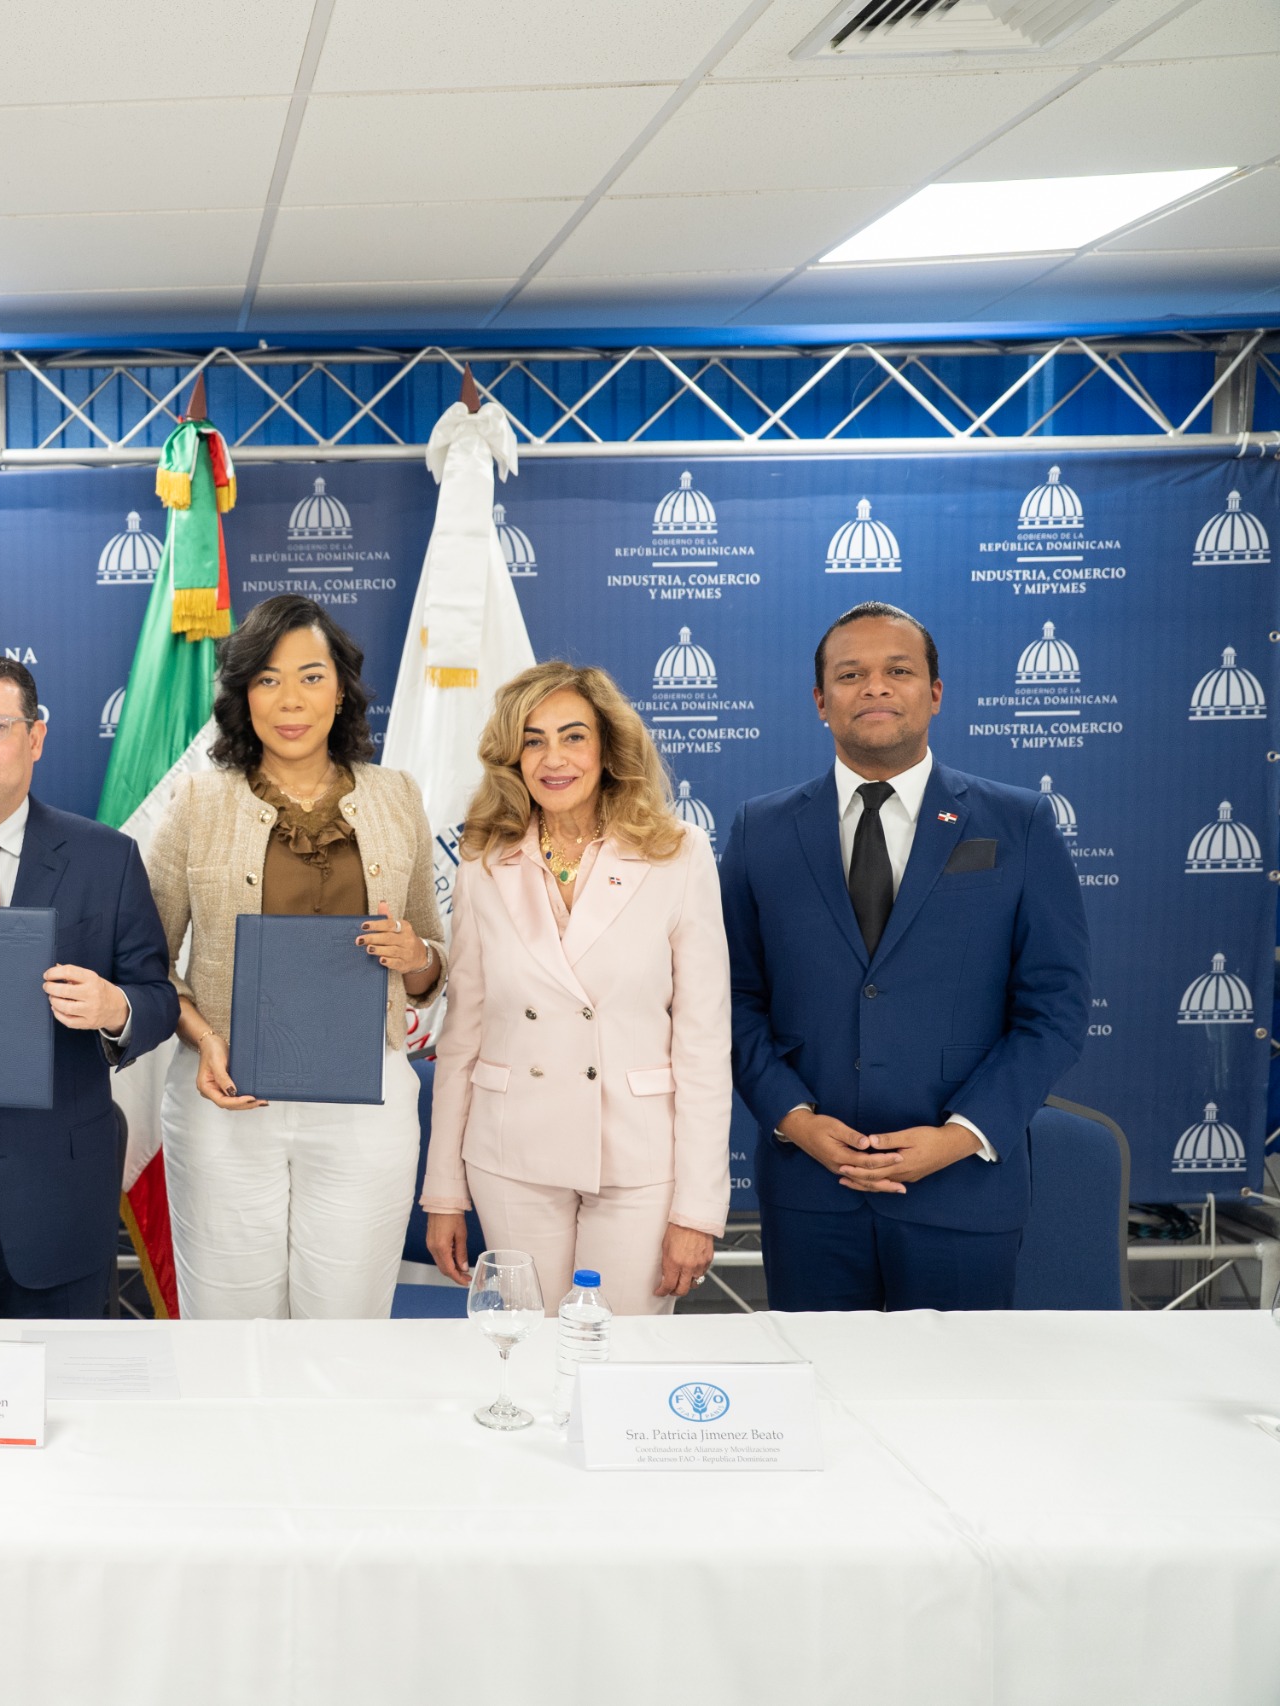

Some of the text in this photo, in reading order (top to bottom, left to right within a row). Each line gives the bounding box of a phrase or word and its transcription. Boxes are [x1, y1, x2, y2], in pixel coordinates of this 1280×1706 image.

[615, 546, 755, 557] REPÚBLICA DOMINICANA
[979, 540, 1121, 552] REPÚBLICA DOMINICANA
[250, 551, 391, 563] REPÚBLICA DOMINICANA
[607, 573, 761, 587] INDUSTRIA, COMERCIO
[971, 567, 1126, 582] INDUSTRIA, COMERCIO
[242, 578, 396, 592] INDUSTRIA, COMERCIO
[1012, 582, 1087, 595] Y MIPYMES
[309, 593, 358, 604] PYMES
[648, 588, 722, 600] Y MIPYMES
[630, 700, 755, 711] PÚBLICA DOMINICANA
[977, 695, 1118, 706] REPÚBLICA DOMINICANA
[688, 727, 760, 739] COMERCIO
[969, 722, 1123, 736] INDUSTRIA, COMERCIO
[660, 741, 721, 753] MIPYMES
[1010, 736, 1084, 749] Y MIPYMES
[1070, 848, 1114, 857] NICANA
[1079, 874, 1119, 886] ERCIO
[625, 1429, 784, 1442] Sra. Patricia Jimenez Beato
